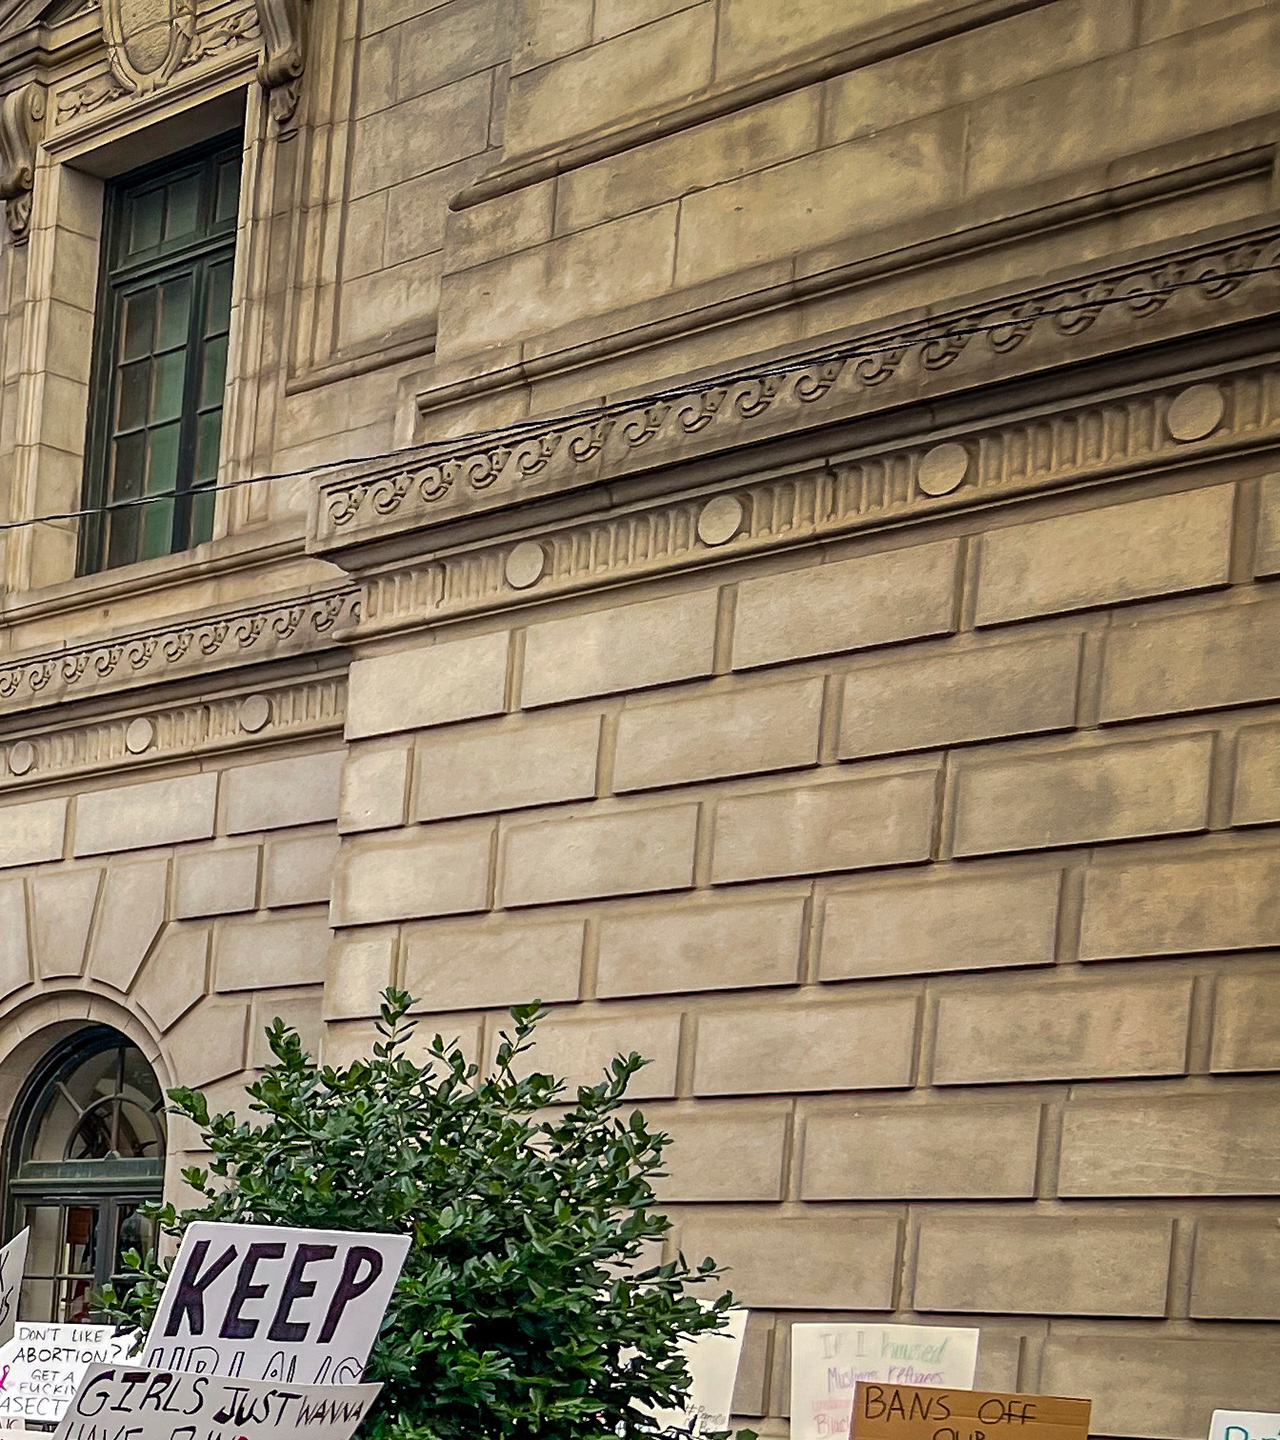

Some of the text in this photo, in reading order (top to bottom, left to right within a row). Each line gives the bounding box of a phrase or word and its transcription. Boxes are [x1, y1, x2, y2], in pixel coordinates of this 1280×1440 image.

[163, 1239, 384, 1345] KEEP
[18, 1327, 106, 1343] DON'T LIKE
[12, 1343, 123, 1366] ABORTION?
[30, 1369, 76, 1383] GET A
[76, 1370, 366, 1428] GIRLS JUST WANNA
[864, 1385, 952, 1423] BANS
[977, 1398, 1038, 1426] OFF
